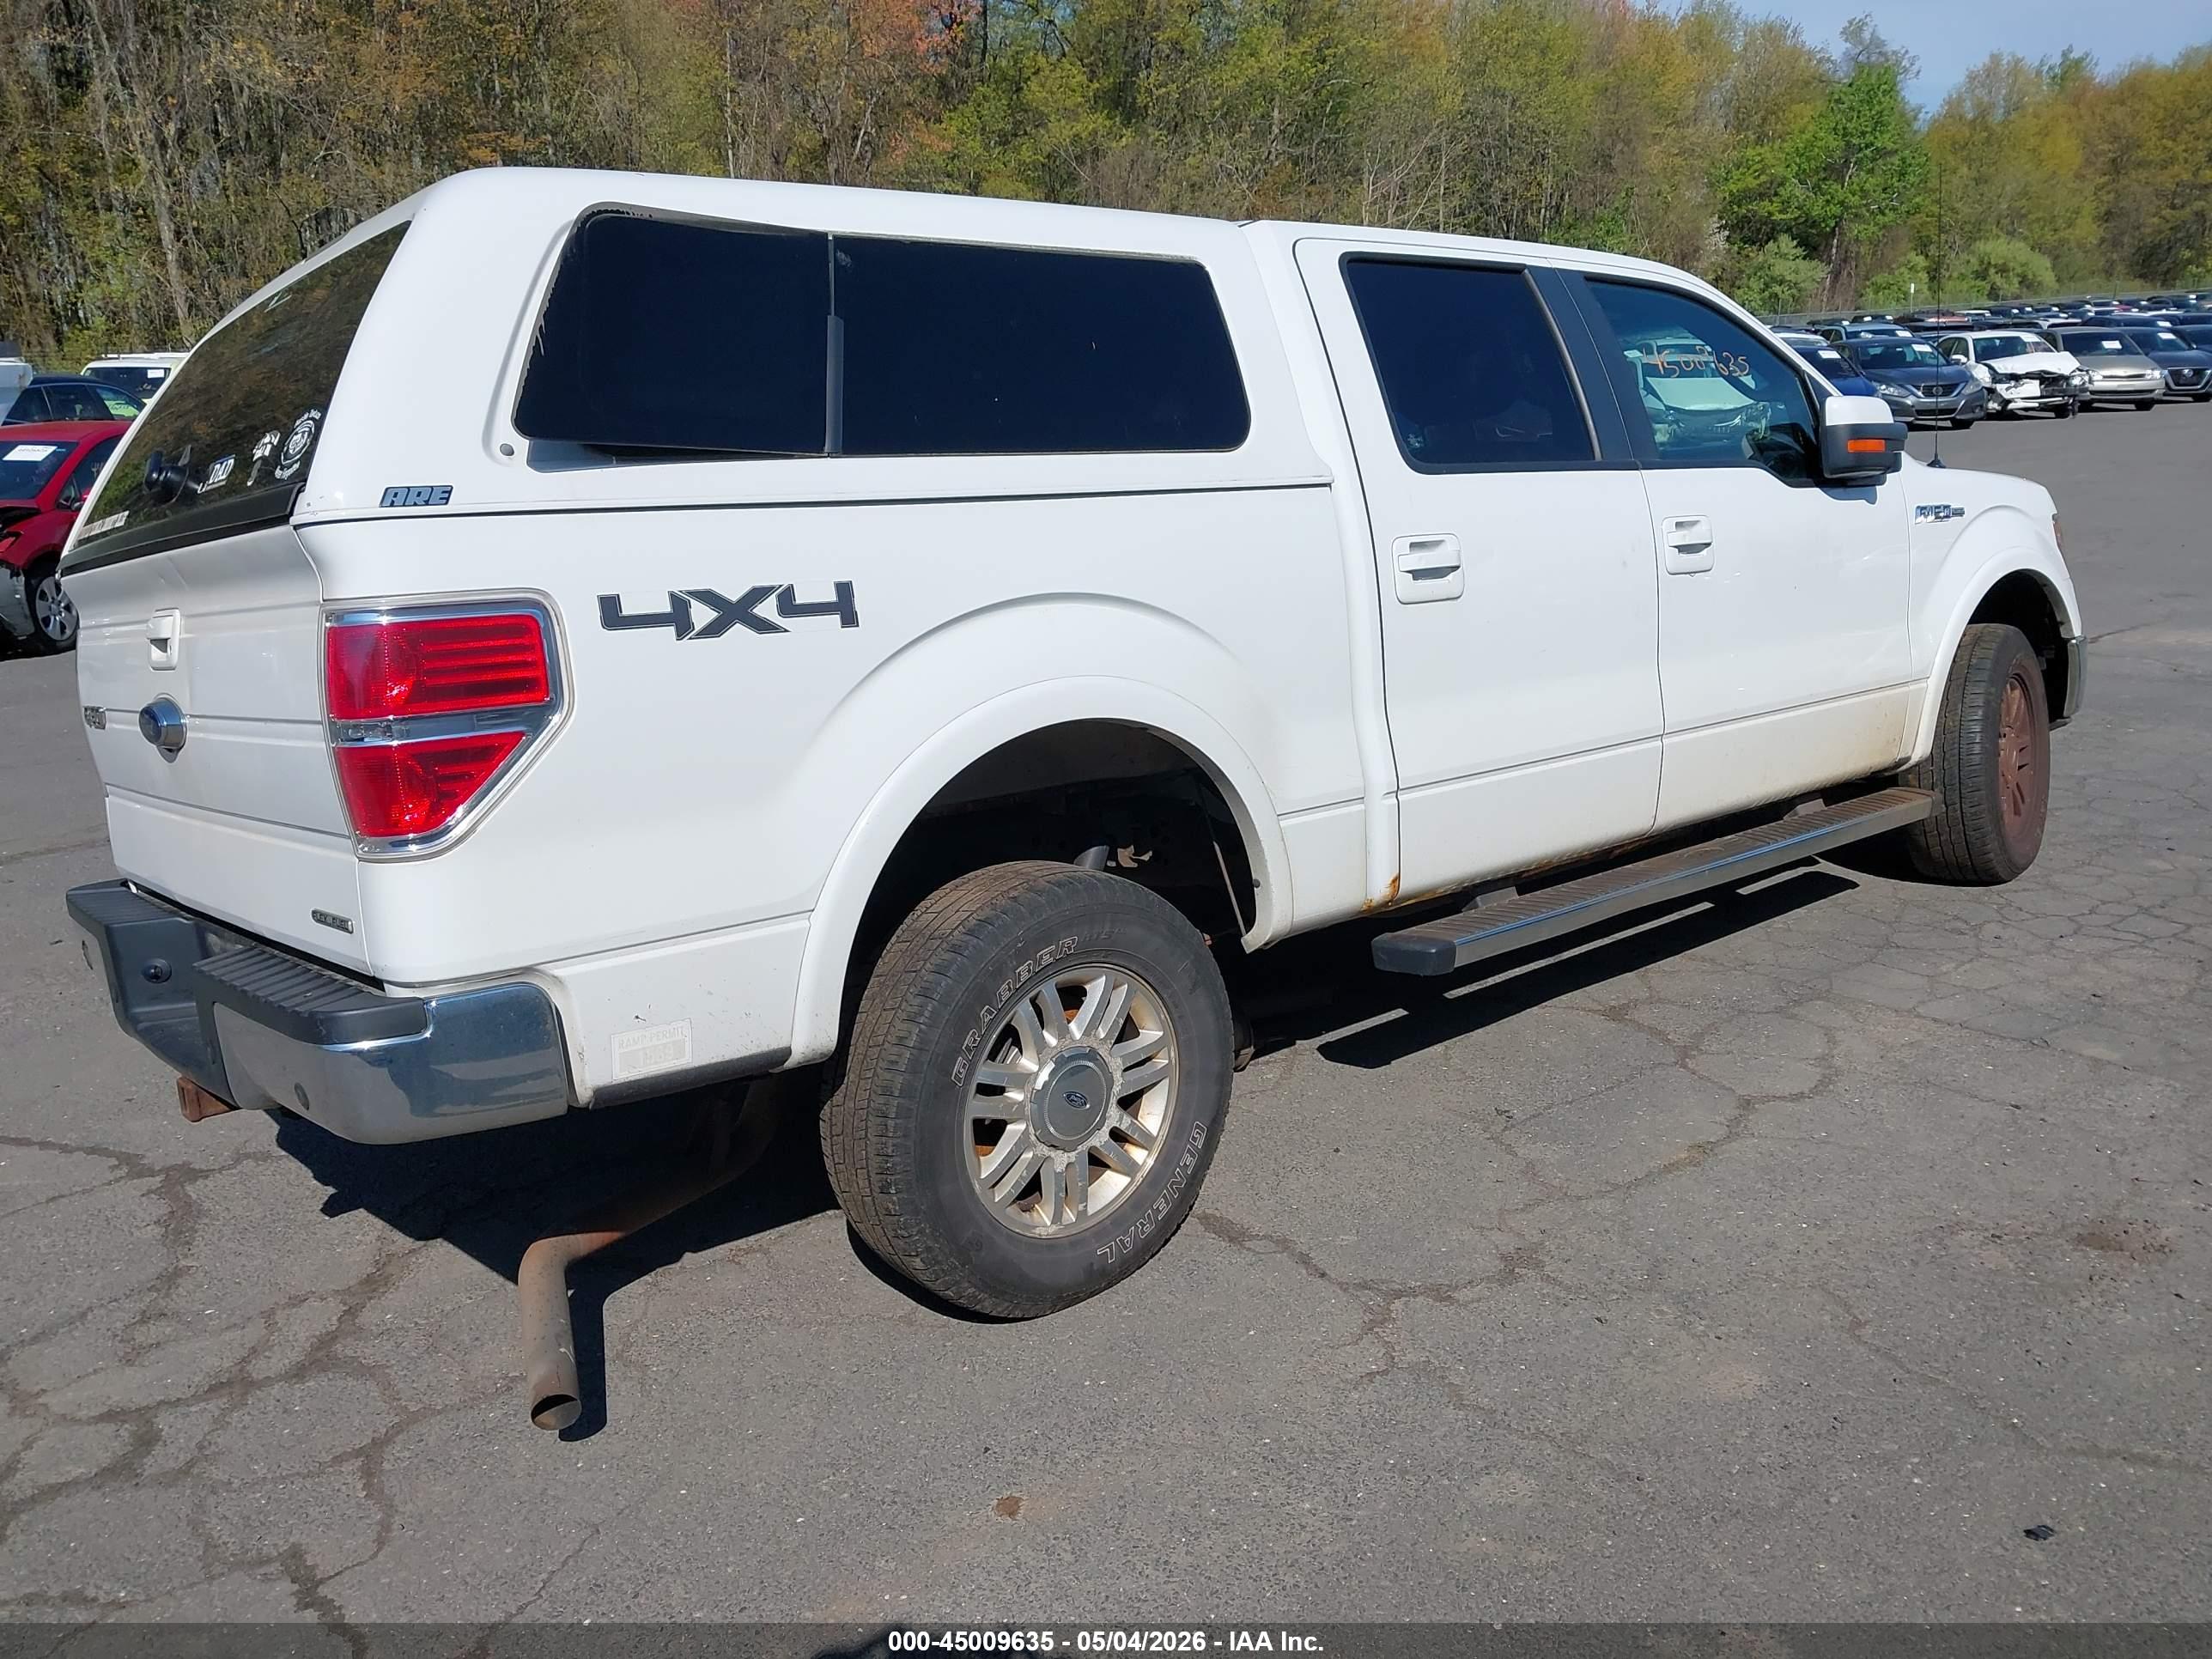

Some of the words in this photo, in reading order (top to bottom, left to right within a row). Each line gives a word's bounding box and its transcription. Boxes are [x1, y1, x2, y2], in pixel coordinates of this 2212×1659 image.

[380, 486, 453, 507] ARE
[951, 936, 1079, 1087] GRABBER
[1097, 1121, 1207, 1264] GENERAL
